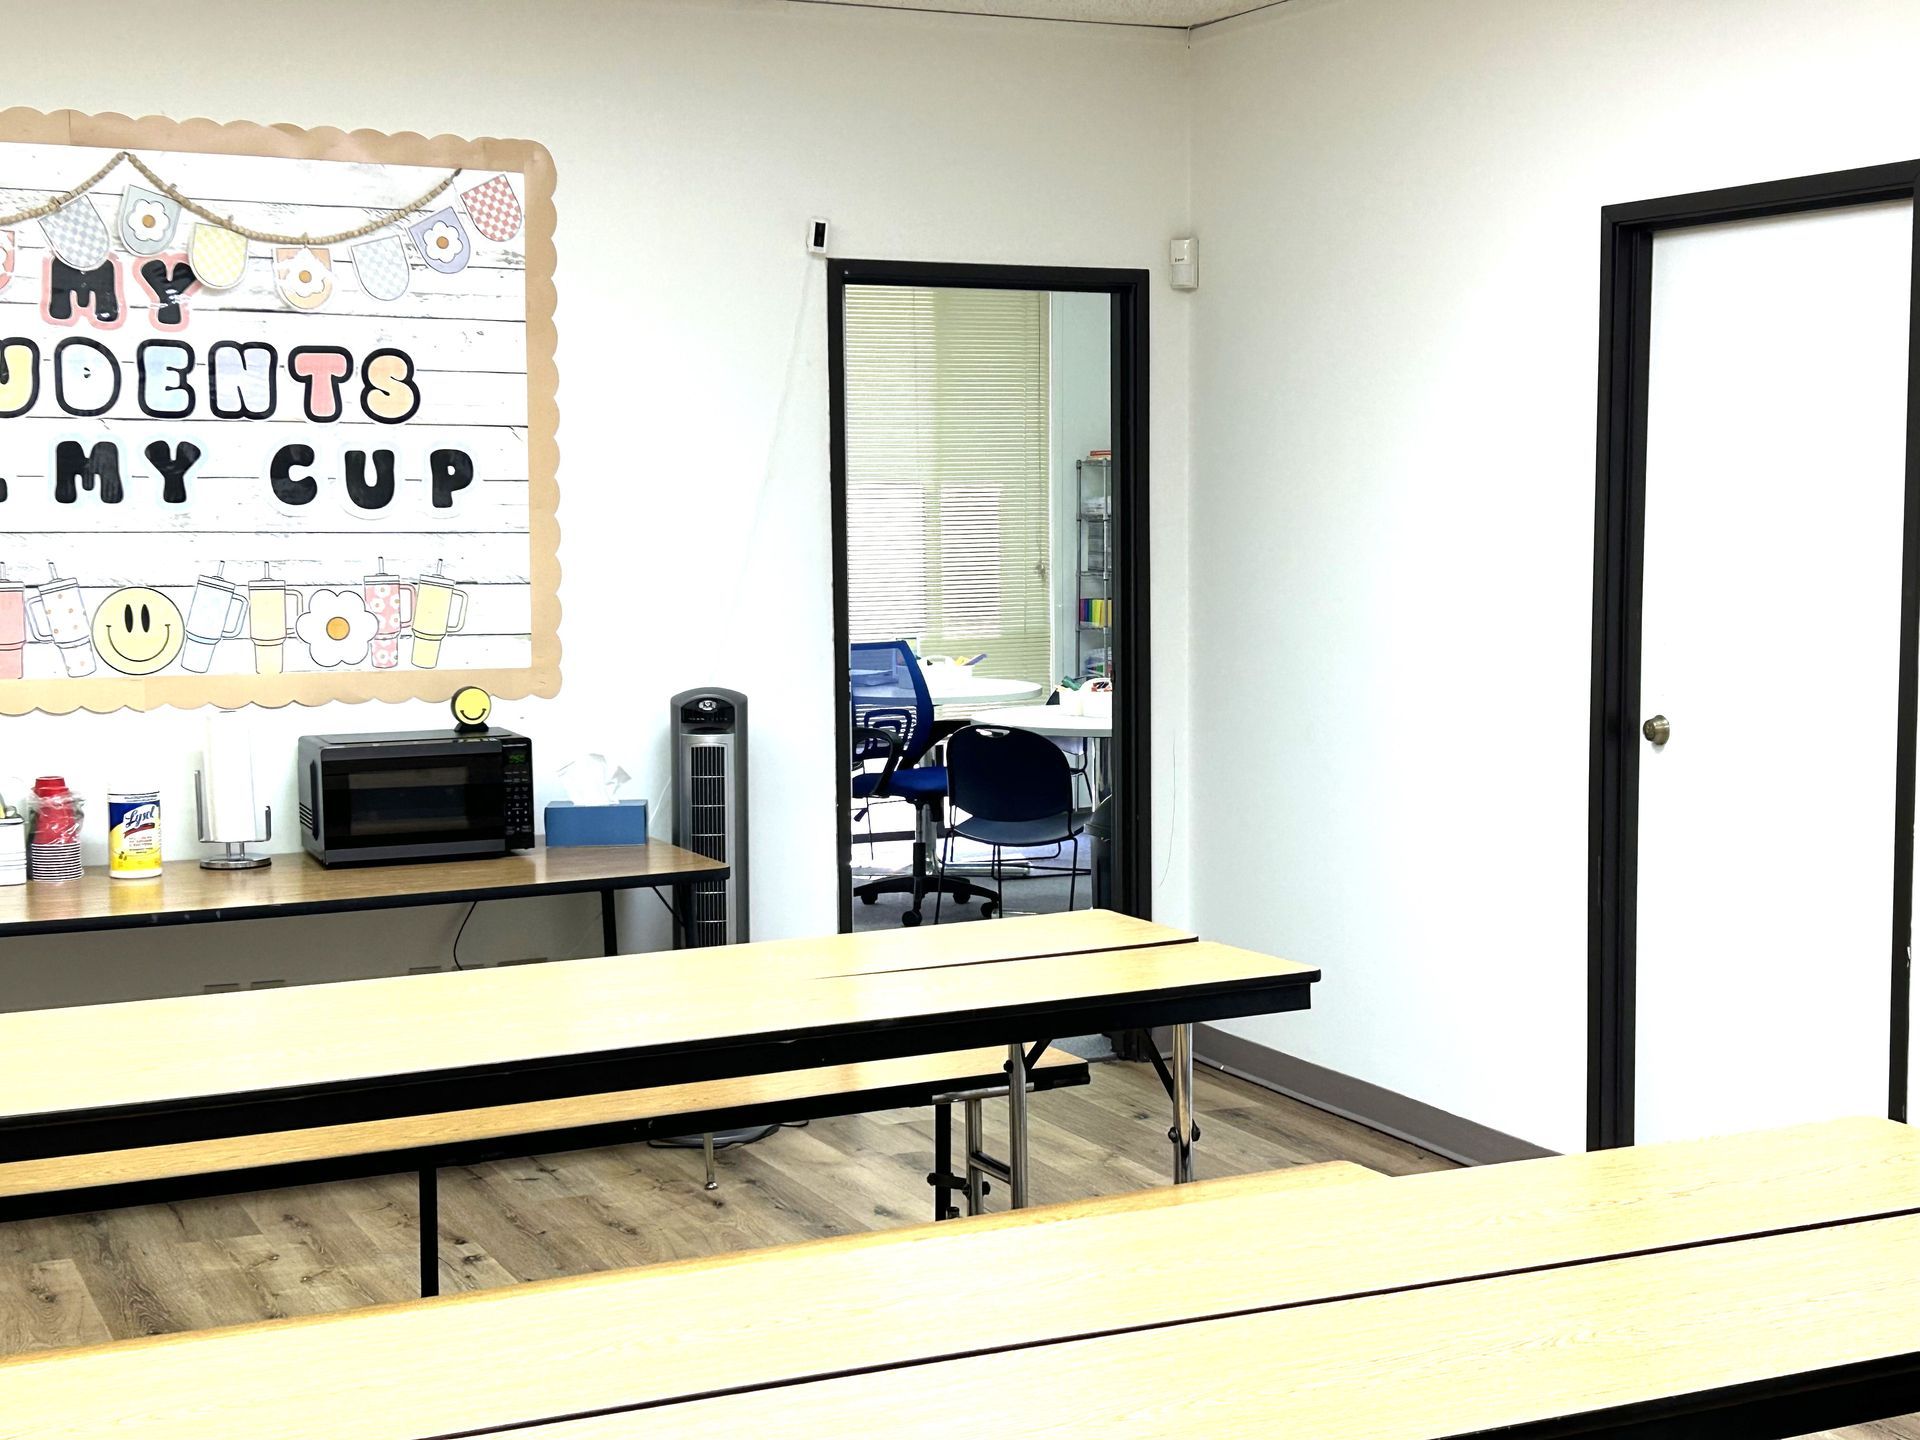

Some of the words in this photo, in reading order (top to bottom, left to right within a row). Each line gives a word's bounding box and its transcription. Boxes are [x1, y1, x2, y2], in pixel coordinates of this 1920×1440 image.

[47, 254, 200, 326] MY
[54, 440, 201, 504] MY
[269, 444, 474, 509] CUP
[125, 805, 156, 828] Lysol
